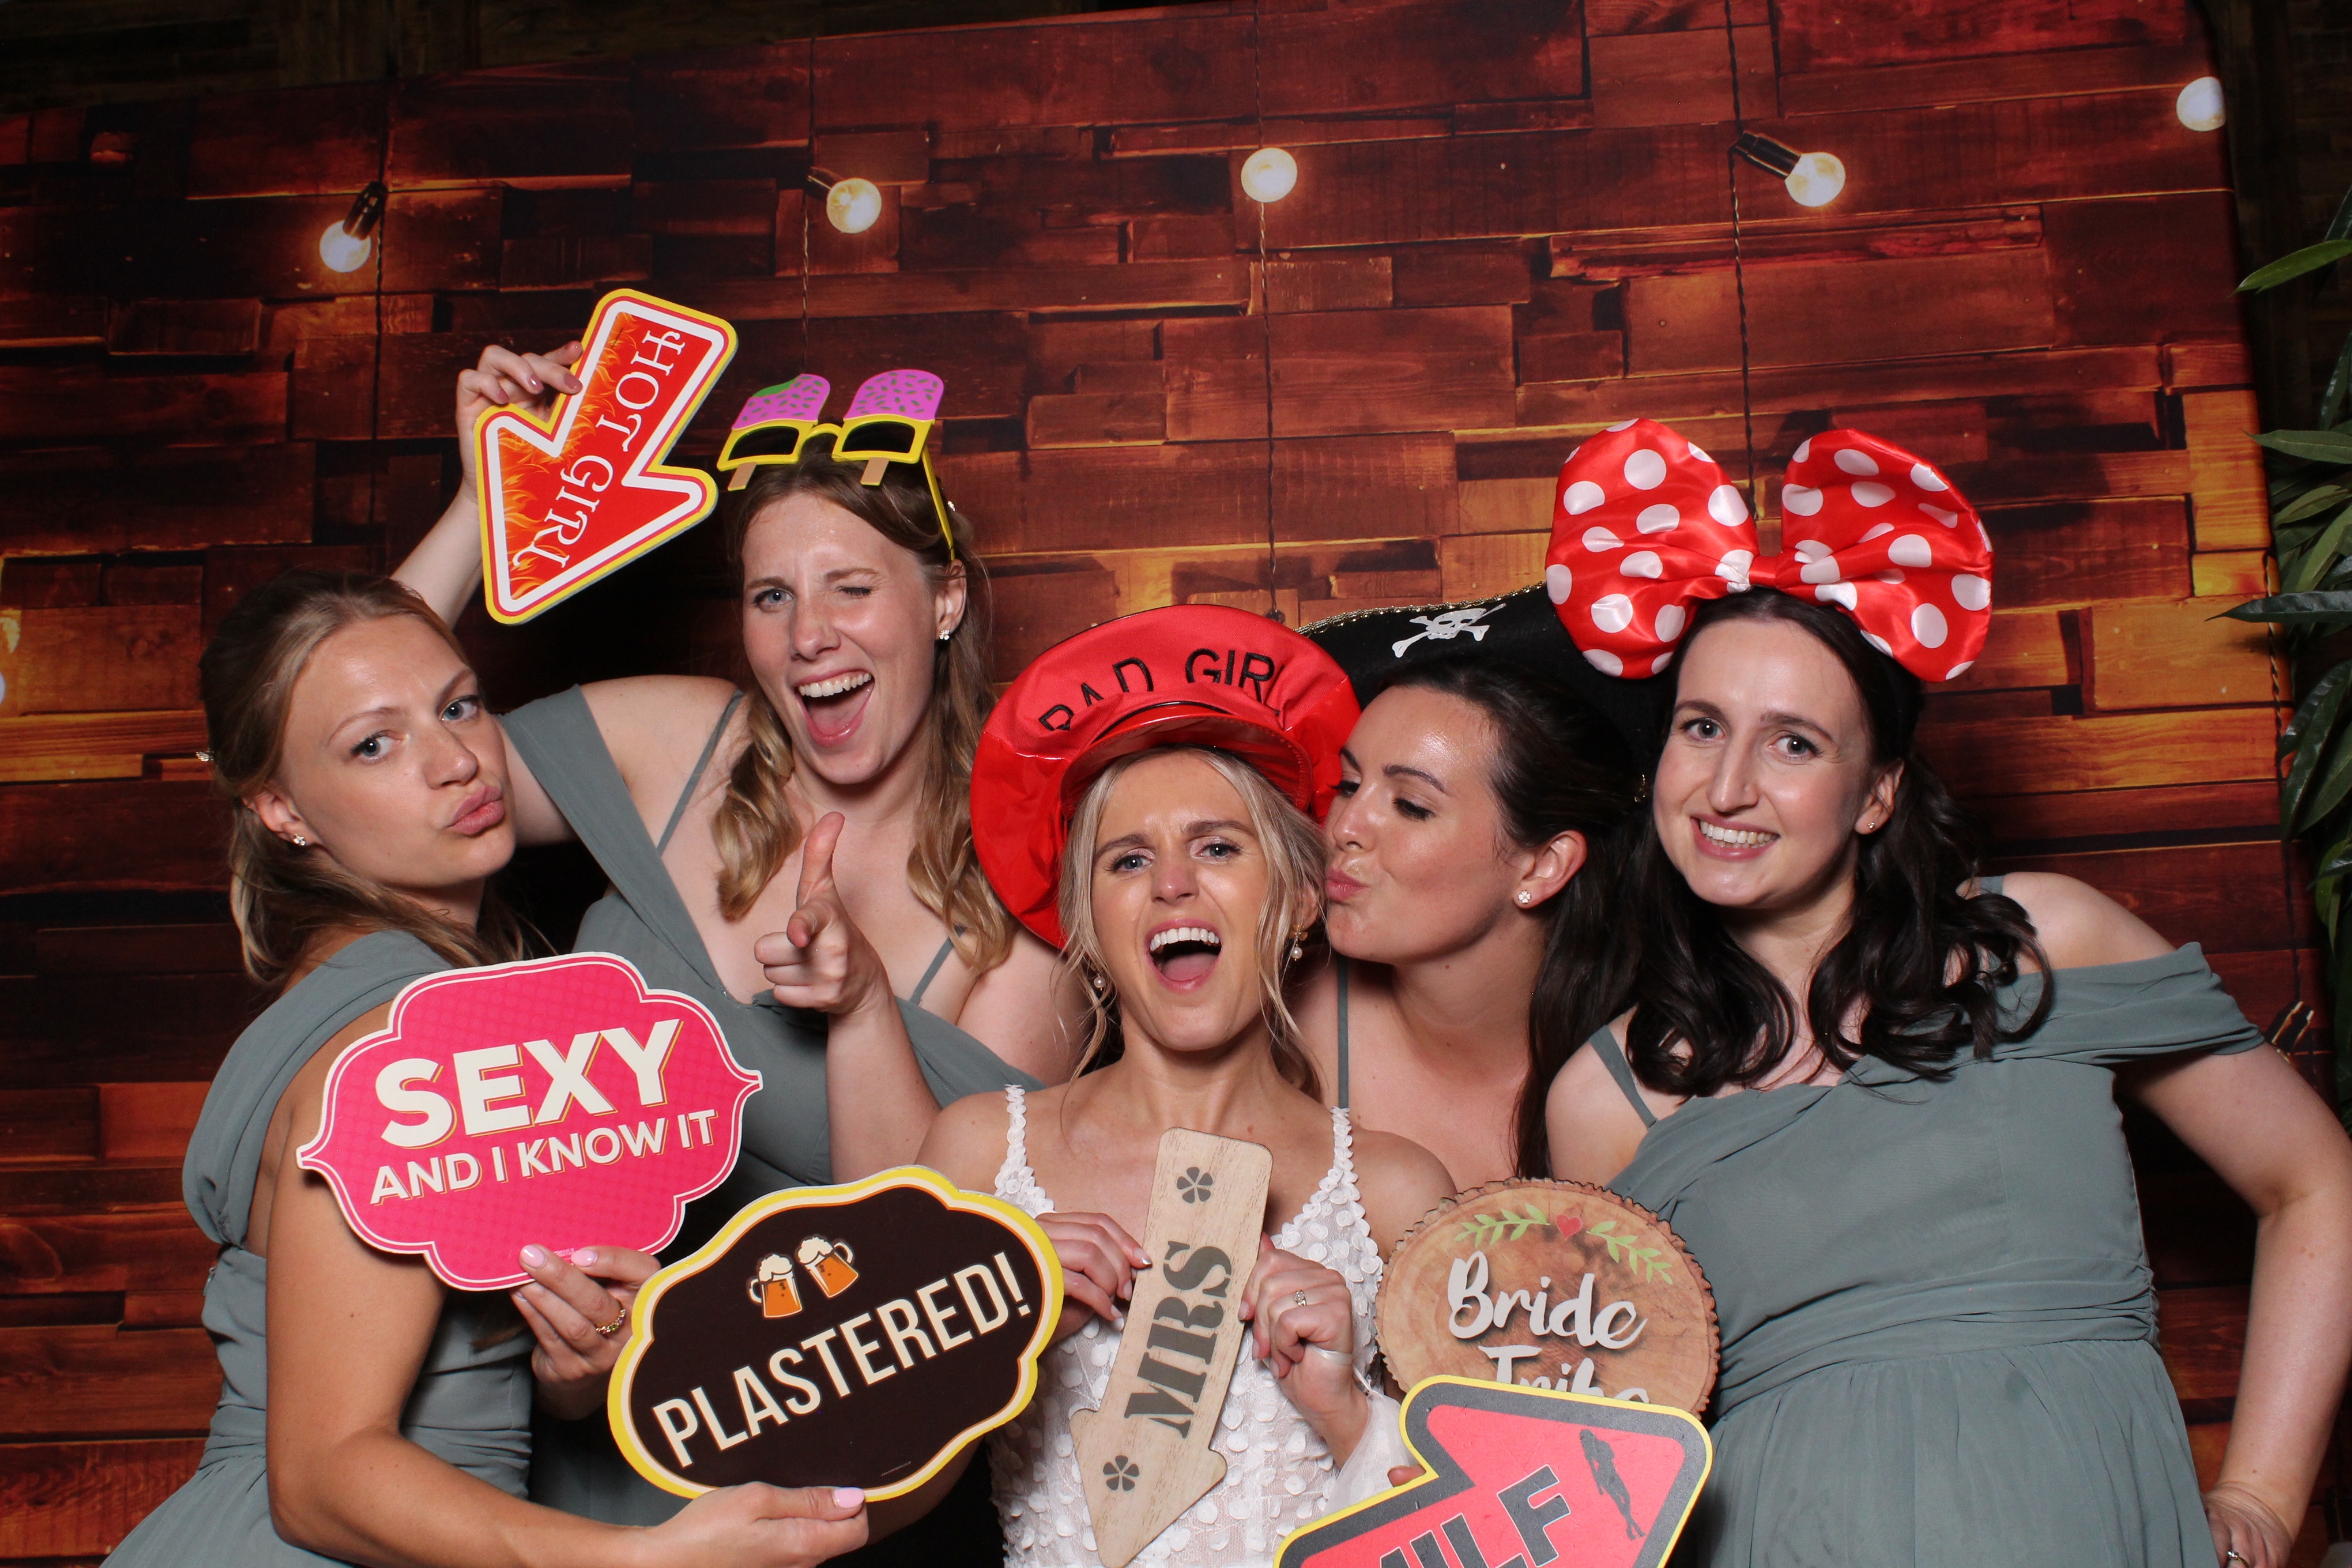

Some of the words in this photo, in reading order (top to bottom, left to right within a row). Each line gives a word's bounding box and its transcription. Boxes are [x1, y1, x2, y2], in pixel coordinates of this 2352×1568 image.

[595, 329, 685, 453] HOT
[512, 454, 613, 569] GIRL
[374, 1018, 685, 1150] SEXY
[370, 1152, 483, 1207] AND
[492, 1146, 509, 1183] I
[519, 1117, 668, 1179] KNOW
[677, 1109, 719, 1150] IT
[1124, 1240, 1232, 1439] MRS
[1447, 1250, 1648, 1350] Bride
[651, 1251, 1032, 1469] PLASTERED!
[1380, 1464, 1571, 1568] LF
